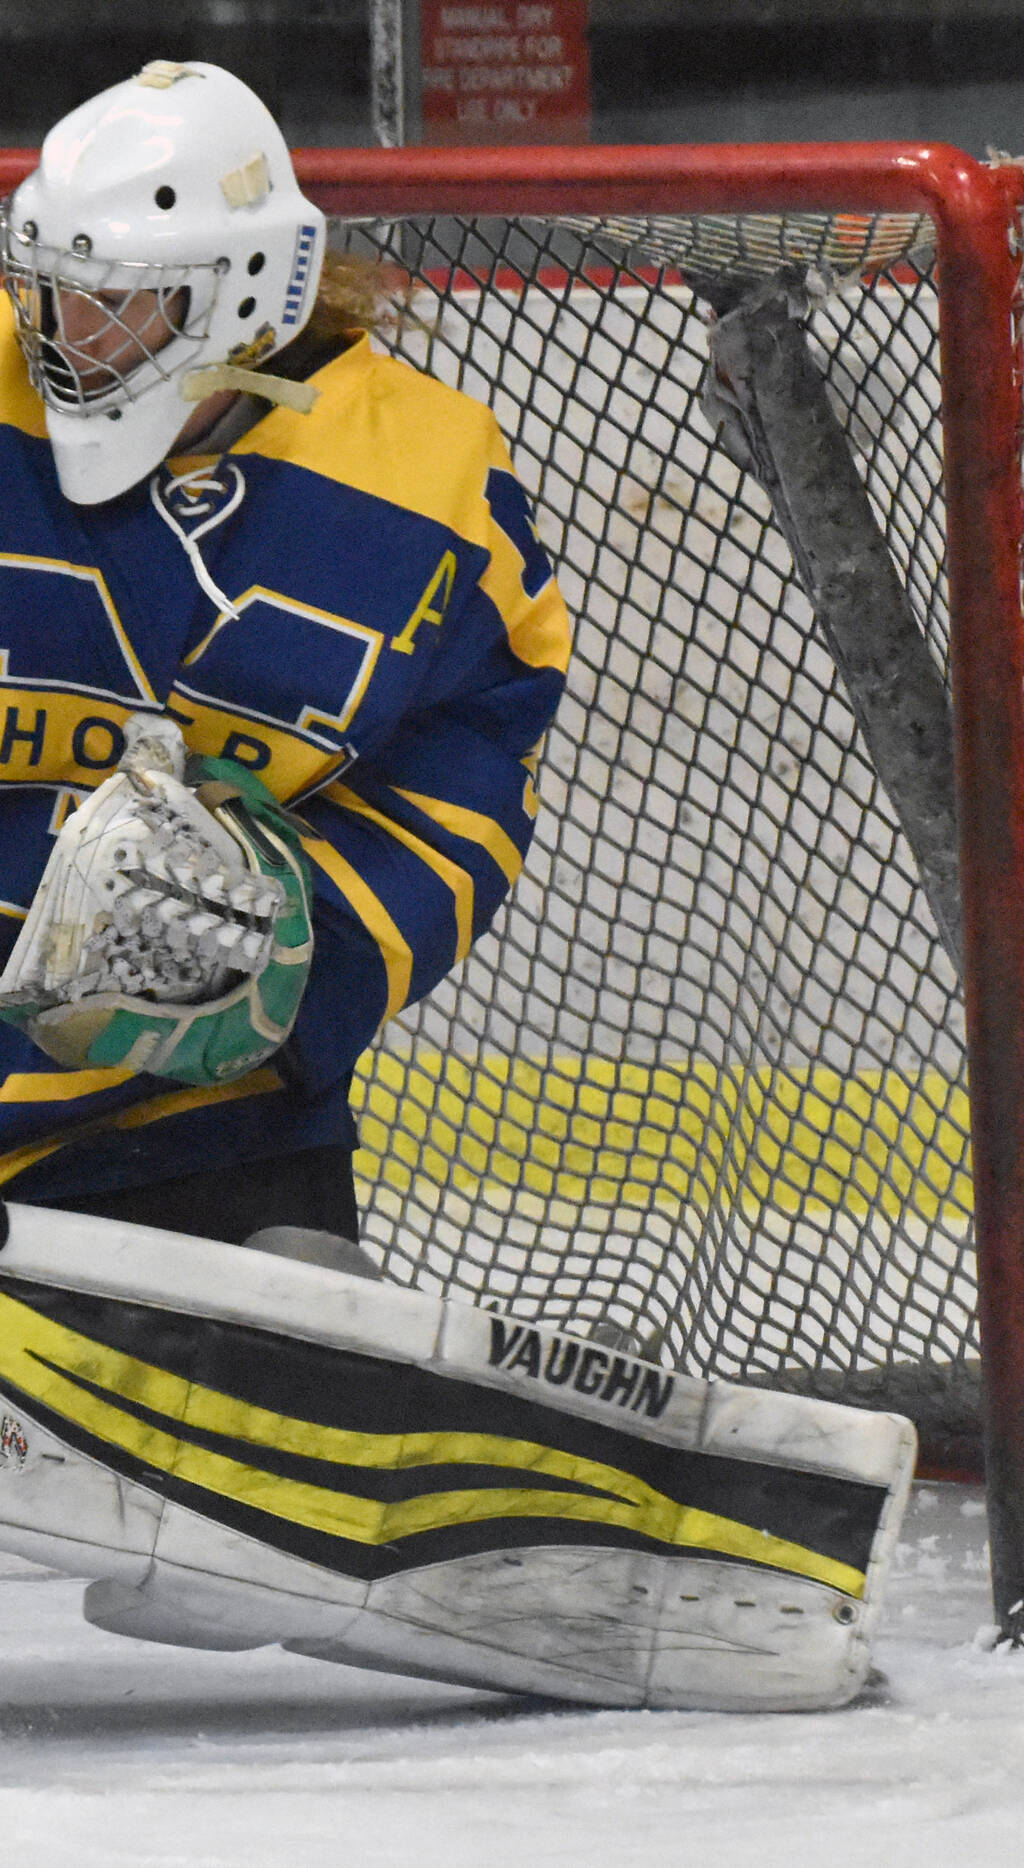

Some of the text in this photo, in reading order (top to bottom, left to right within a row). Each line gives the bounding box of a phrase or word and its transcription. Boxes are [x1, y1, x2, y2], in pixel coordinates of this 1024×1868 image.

[440, 5, 554, 31] MANUAL DRY
[524, 35, 563, 61] FOR
[459, 65, 574, 92] DEPARTMENT
[456, 98, 536, 122] USE ONLY
[389, 549, 457, 656] A
[488, 1316, 676, 1419] VAUGHN
